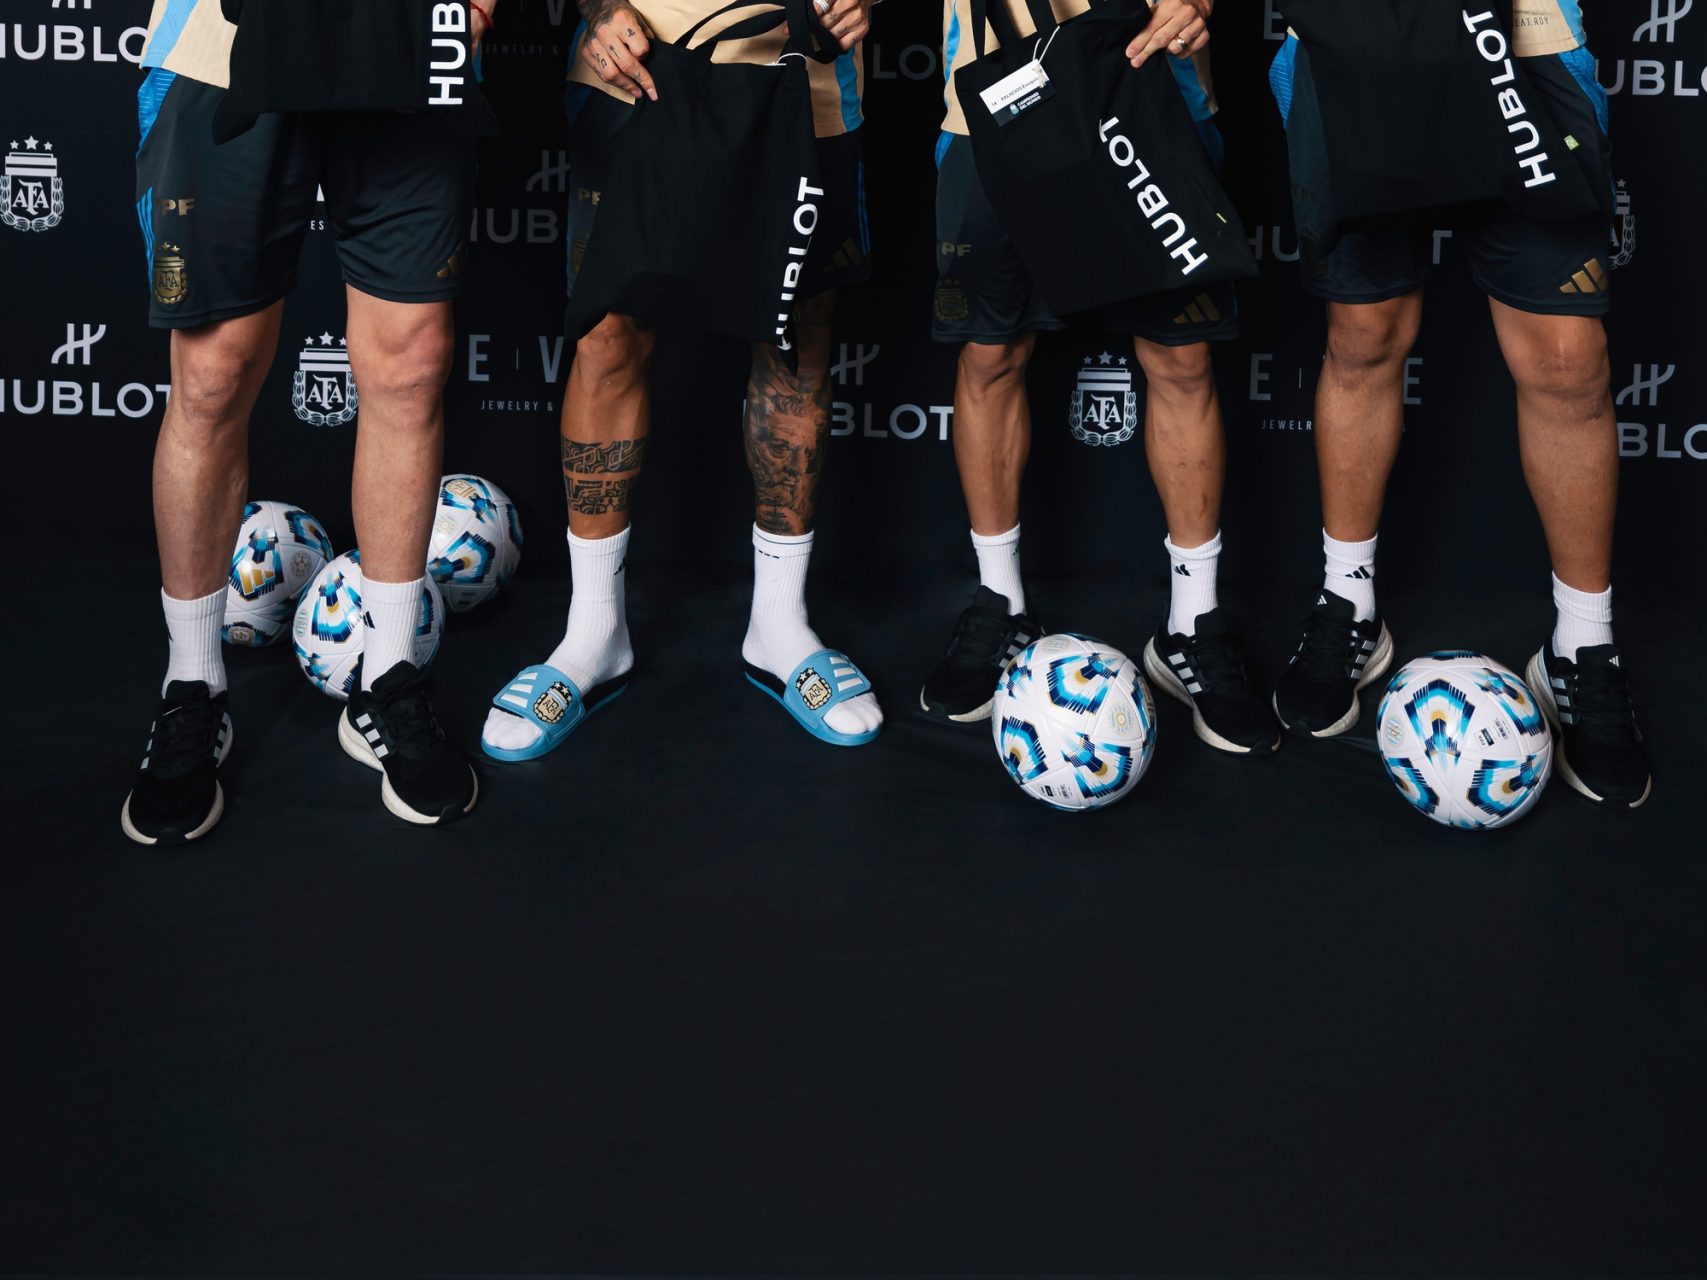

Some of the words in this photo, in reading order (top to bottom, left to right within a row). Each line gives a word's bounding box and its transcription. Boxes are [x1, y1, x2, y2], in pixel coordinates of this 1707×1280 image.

[0, 23, 148, 63] UBLO
[1463, 8, 1557, 189] HUBLOT
[12, 178, 49, 216] AFA
[160, 198, 196, 216] PF
[1099, 116, 1209, 276] HUBLOT
[941, 240, 972, 257] PF
[0, 378, 171, 418] UBLO
[481, 400, 538, 411] JEWELRY
[1082, 393, 1122, 430] AFA
[831, 401, 954, 440] BLOT
[1261, 420, 1312, 431] JEWELR
[1617, 421, 1707, 460] BLO
